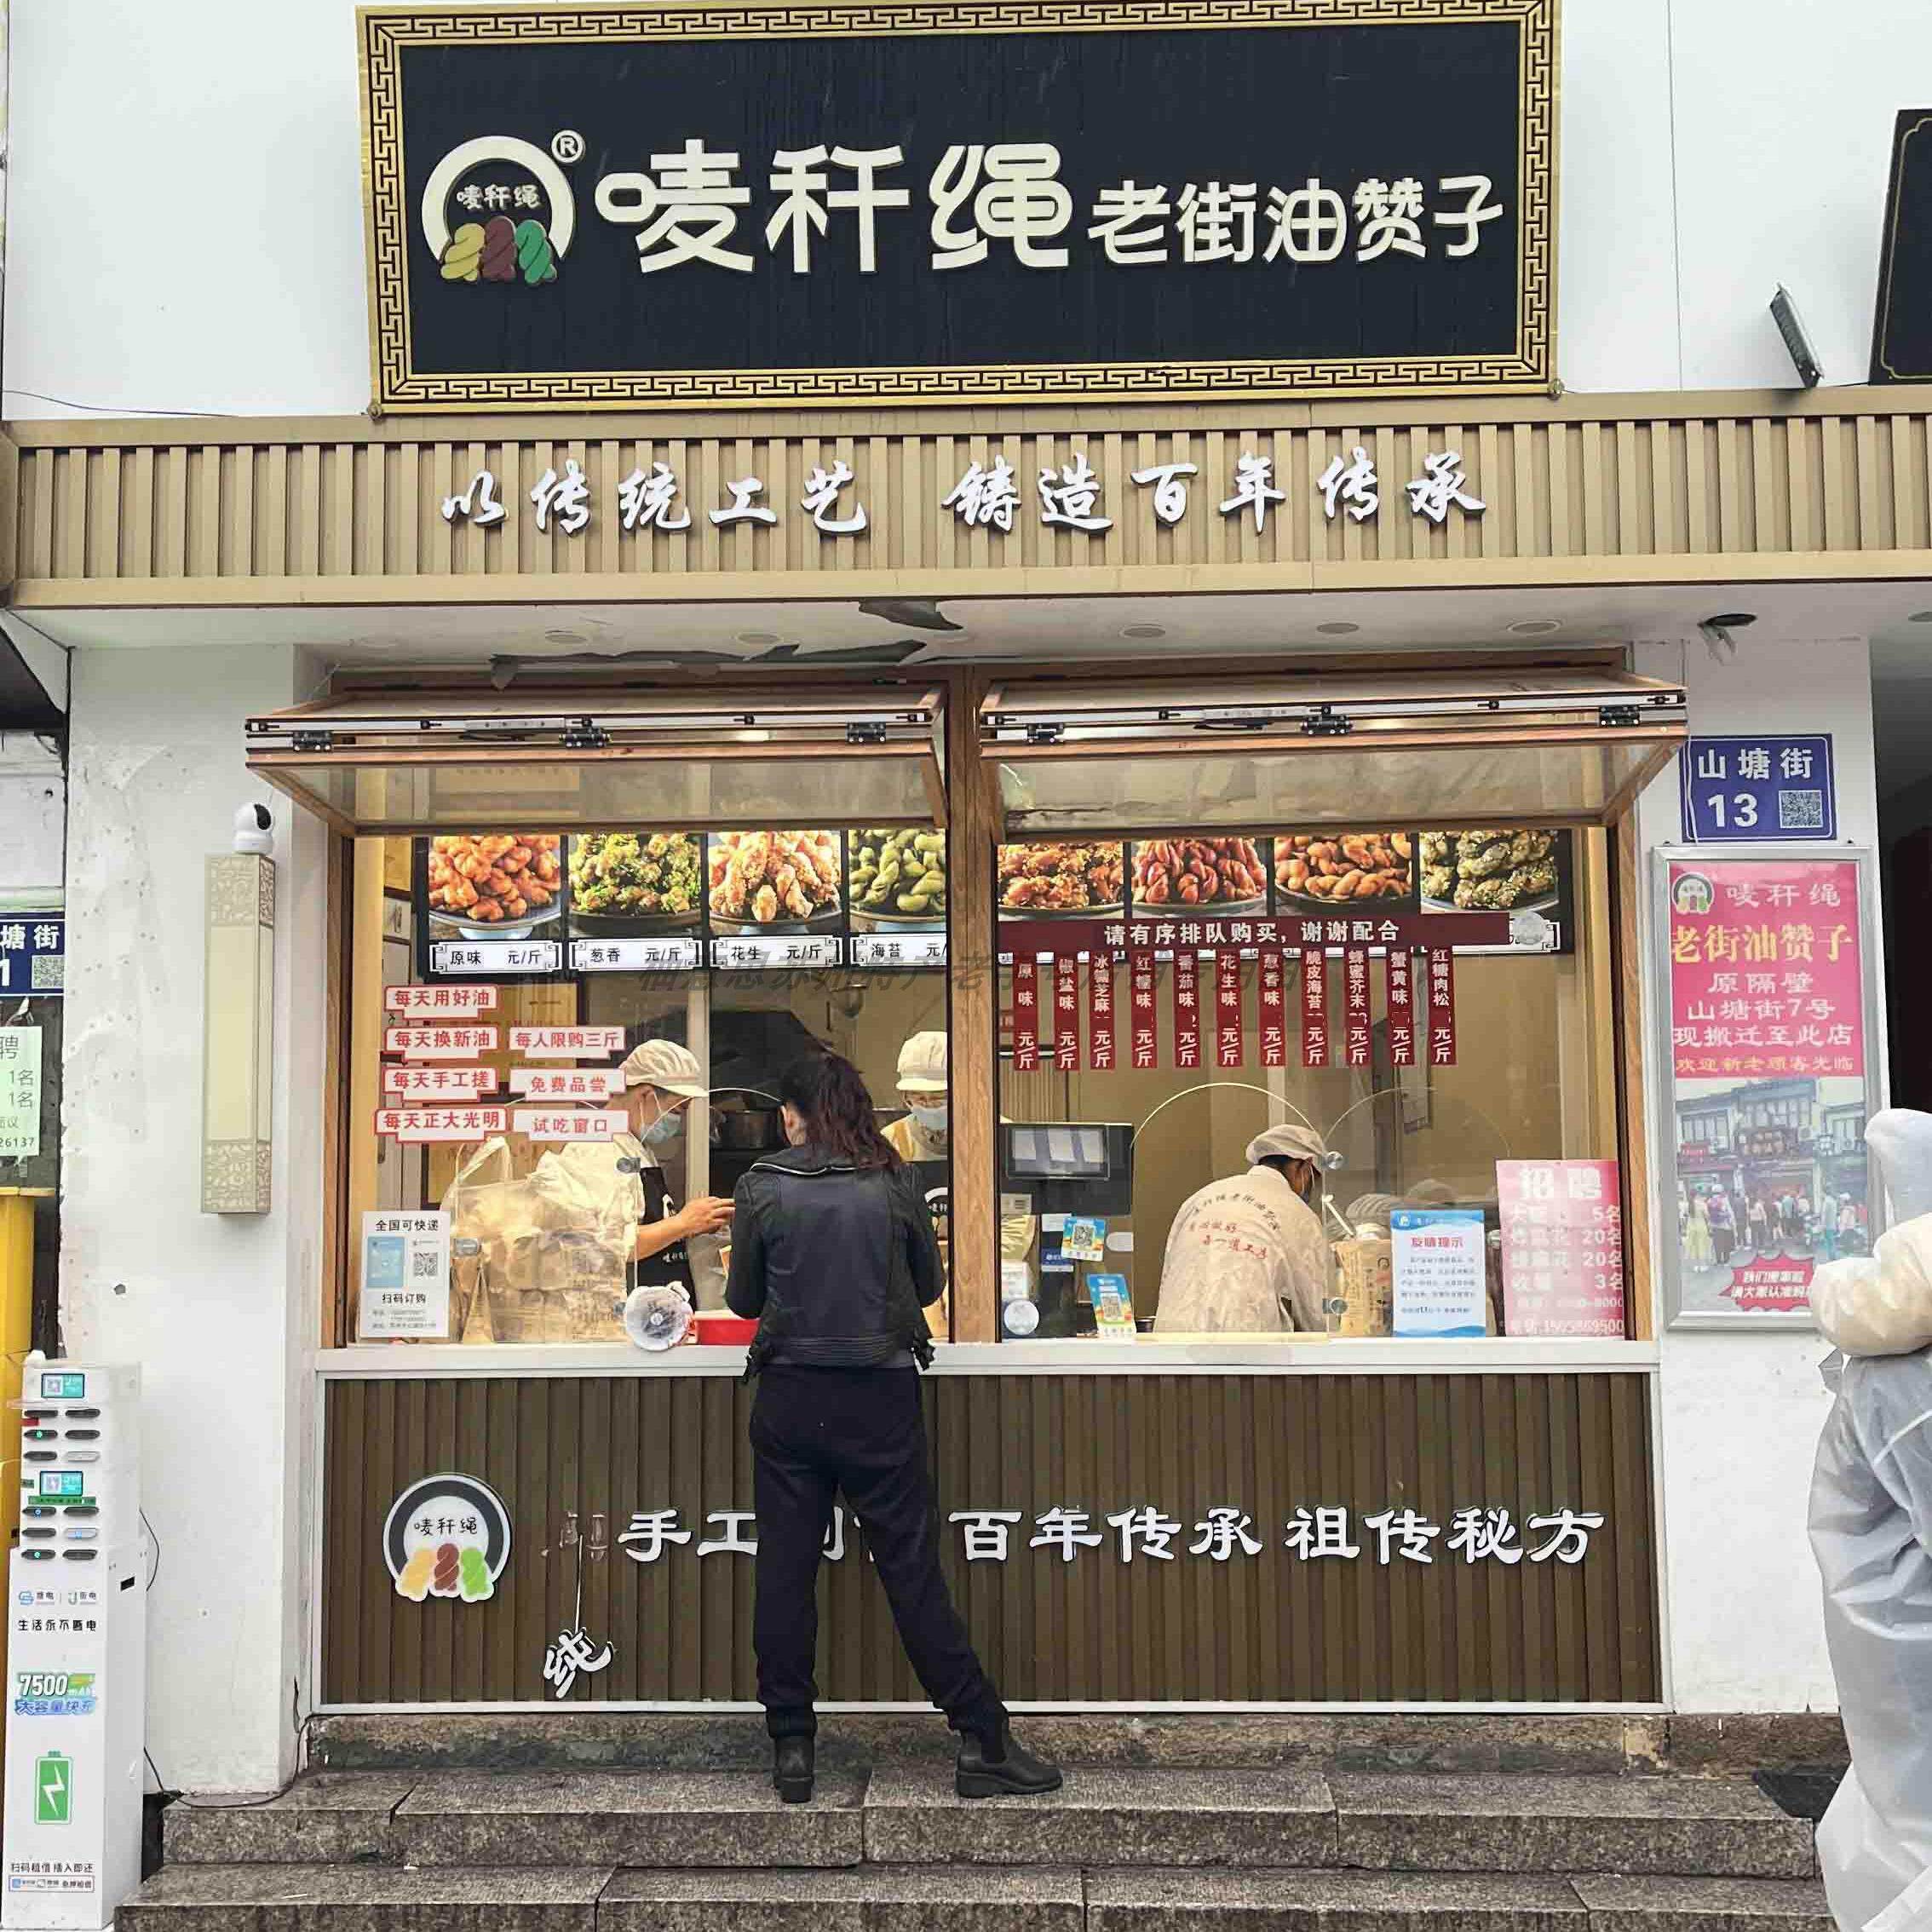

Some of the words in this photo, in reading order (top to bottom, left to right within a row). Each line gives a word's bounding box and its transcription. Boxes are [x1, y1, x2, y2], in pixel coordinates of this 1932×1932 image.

[595, 138, 1072, 273] 唛秆绳
[1088, 175, 1504, 265] 老街油赞子
[442, 459, 866, 535] 以传统工艺
[942, 447, 1486, 536] 铸造百年传承
[1698, 747, 1814, 780] 山塘街
[1708, 793, 1758, 827] 13
[731, 946, 762, 961] 花生
[786, 945, 823, 960] 元/斤
[871, 944, 901, 958] 海苔
[1672, 924, 1853, 963] 老街油赞子
[450, 951, 481, 965] 原味
[508, 950, 542, 964] 元/斤
[590, 948, 620, 963] 葱香
[645, 947, 681, 963] 元/斤
[1018, 963, 1033, 1006] 原味
[1221, 955, 1237, 1006] 花生味
[1708, 972, 1813, 994] 原隔壁
[395, 990, 489, 1007] 每天用好油
[1688, 998, 1836, 1021] 山塘街7号
[395, 1031, 489, 1048] 每天换新油
[515, 1032, 619, 1048] 每人限购三斤
[1672, 1025, 1854, 1047] 现搬迁至此店
[532, 1076, 606, 1092] 免费品尝
[383, 1111, 499, 1130] 每天正大光明
[532, 1118, 607, 1134] 试吃窗口
[376, 1219, 440, 1232] 全国可快递
[949, 1506, 1263, 1565] 百年传承
[1285, 1506, 1606, 1566] 祖传秘方
[20, 1674, 67, 1696] 7500
